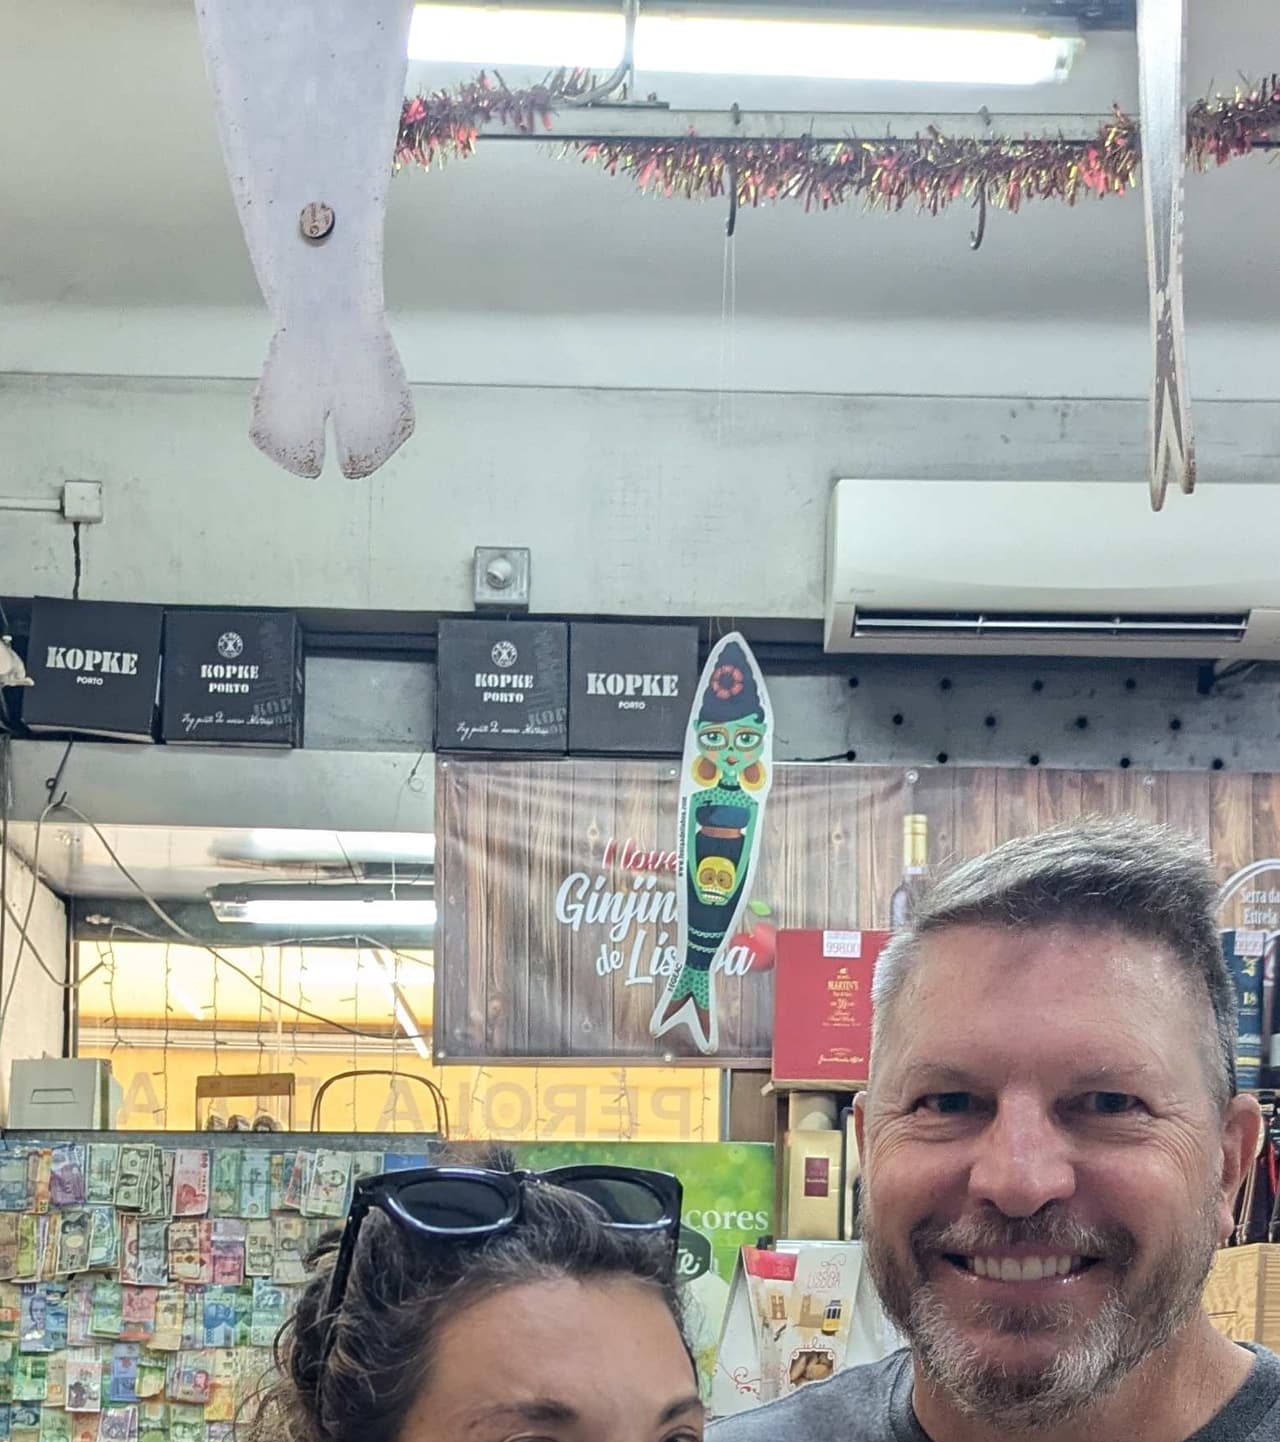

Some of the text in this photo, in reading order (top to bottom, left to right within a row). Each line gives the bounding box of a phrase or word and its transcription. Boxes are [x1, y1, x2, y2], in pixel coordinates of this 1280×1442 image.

[45, 646, 139, 675] KOPKE
[200, 664, 260, 679] KOPKE
[76, 675, 104, 686] PORTO
[208, 682, 250, 694] PORTO
[475, 673, 535, 688] KOPKE
[586, 672, 679, 697] KOPKE
[482, 691, 525, 703] PORTO
[619, 701, 646, 711] PORTO
[595, 929, 756, 986] de Lisa
[685, 1207, 769, 1231] cores
